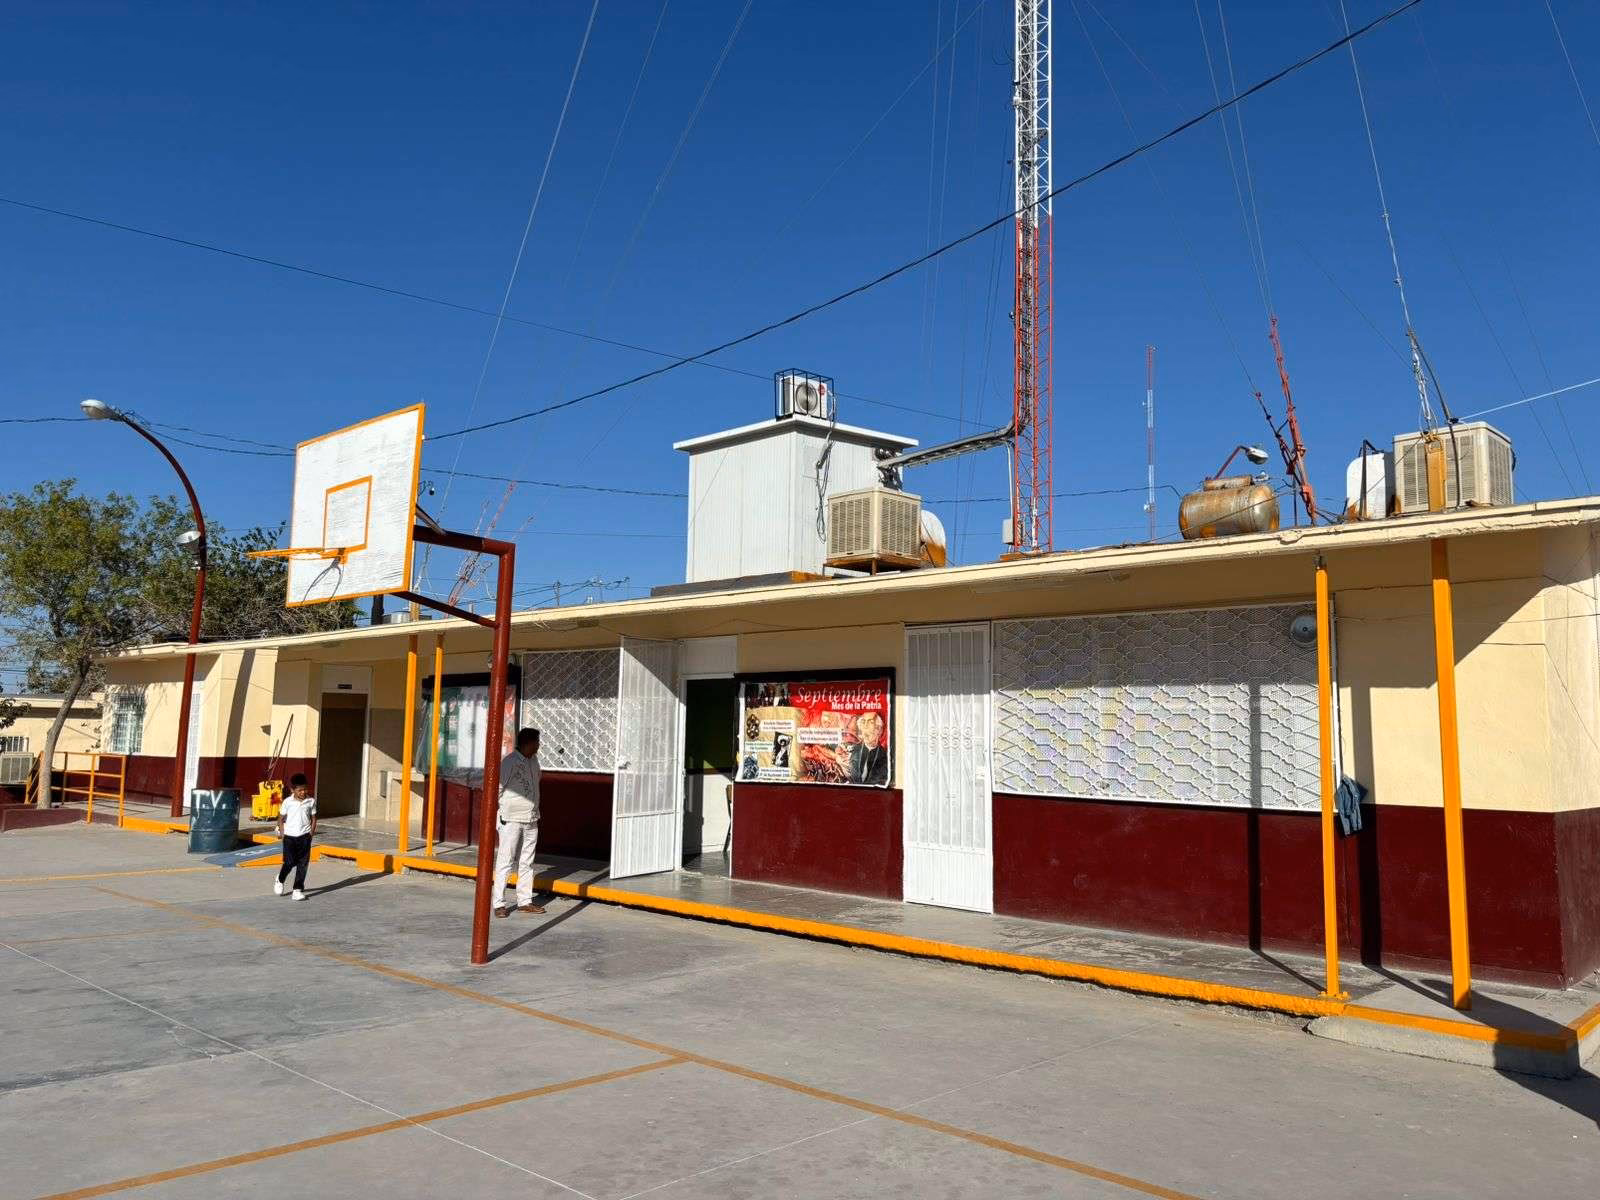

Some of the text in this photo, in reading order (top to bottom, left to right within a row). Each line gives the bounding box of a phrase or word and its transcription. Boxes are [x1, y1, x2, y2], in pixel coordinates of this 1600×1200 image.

[796, 683, 882, 709] Septiembre
[831, 700, 882, 710] Mes de la Patria
